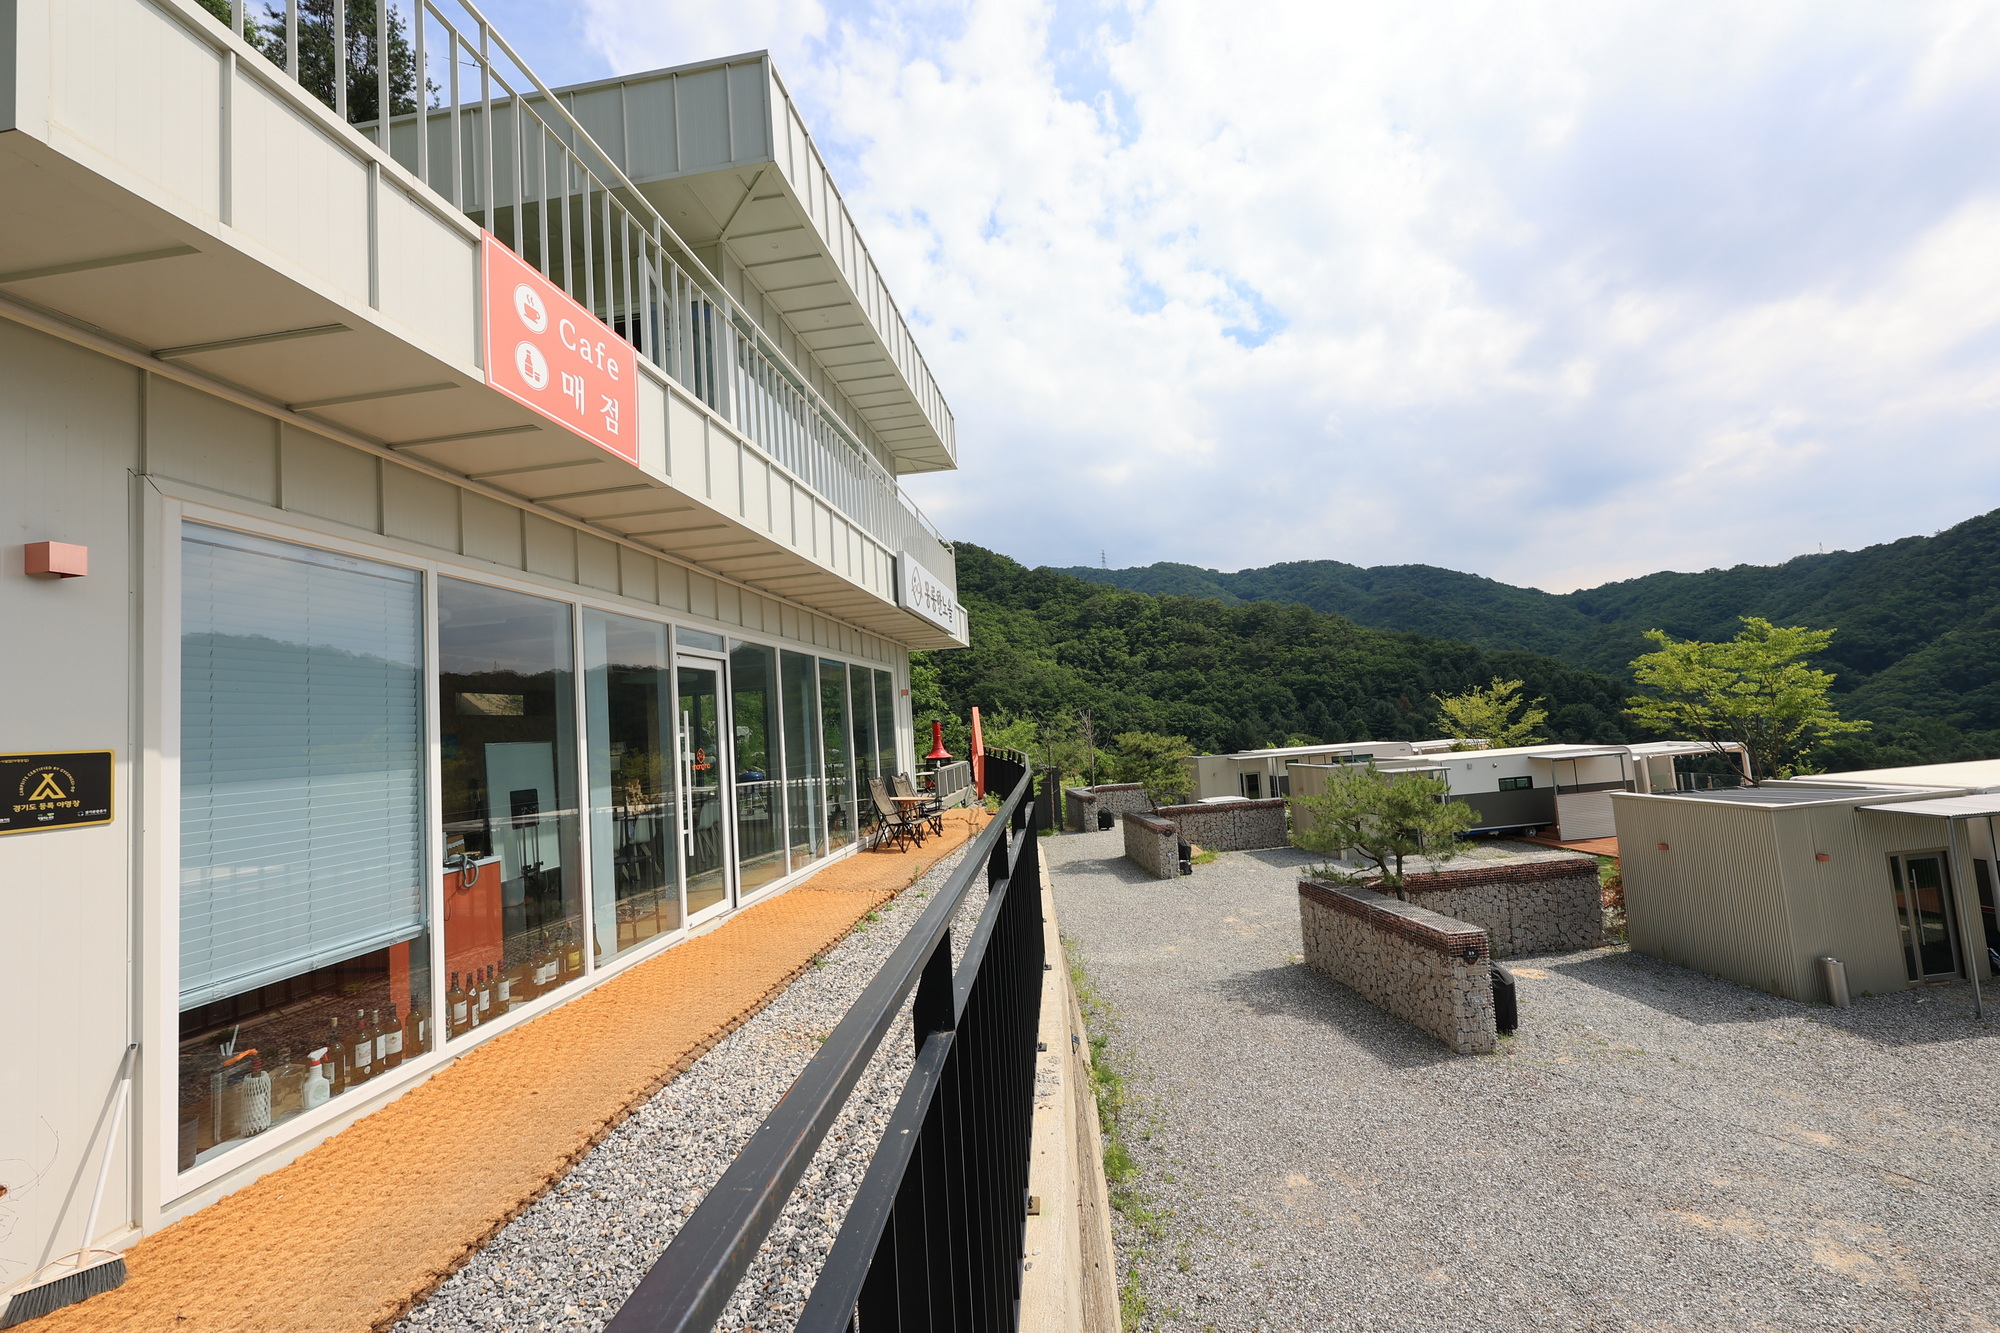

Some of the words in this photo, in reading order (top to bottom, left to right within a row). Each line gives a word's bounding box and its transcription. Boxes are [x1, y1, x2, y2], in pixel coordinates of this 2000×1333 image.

[559, 318, 619, 381] Cafe
[19, 776, 29, 796] CAMPSITE
[27, 766, 52, 777] CERTIFIED
[13, 803, 37, 813] 경기도
[39, 802, 54, 810] 등록
[56, 800, 80, 809] 야영장
